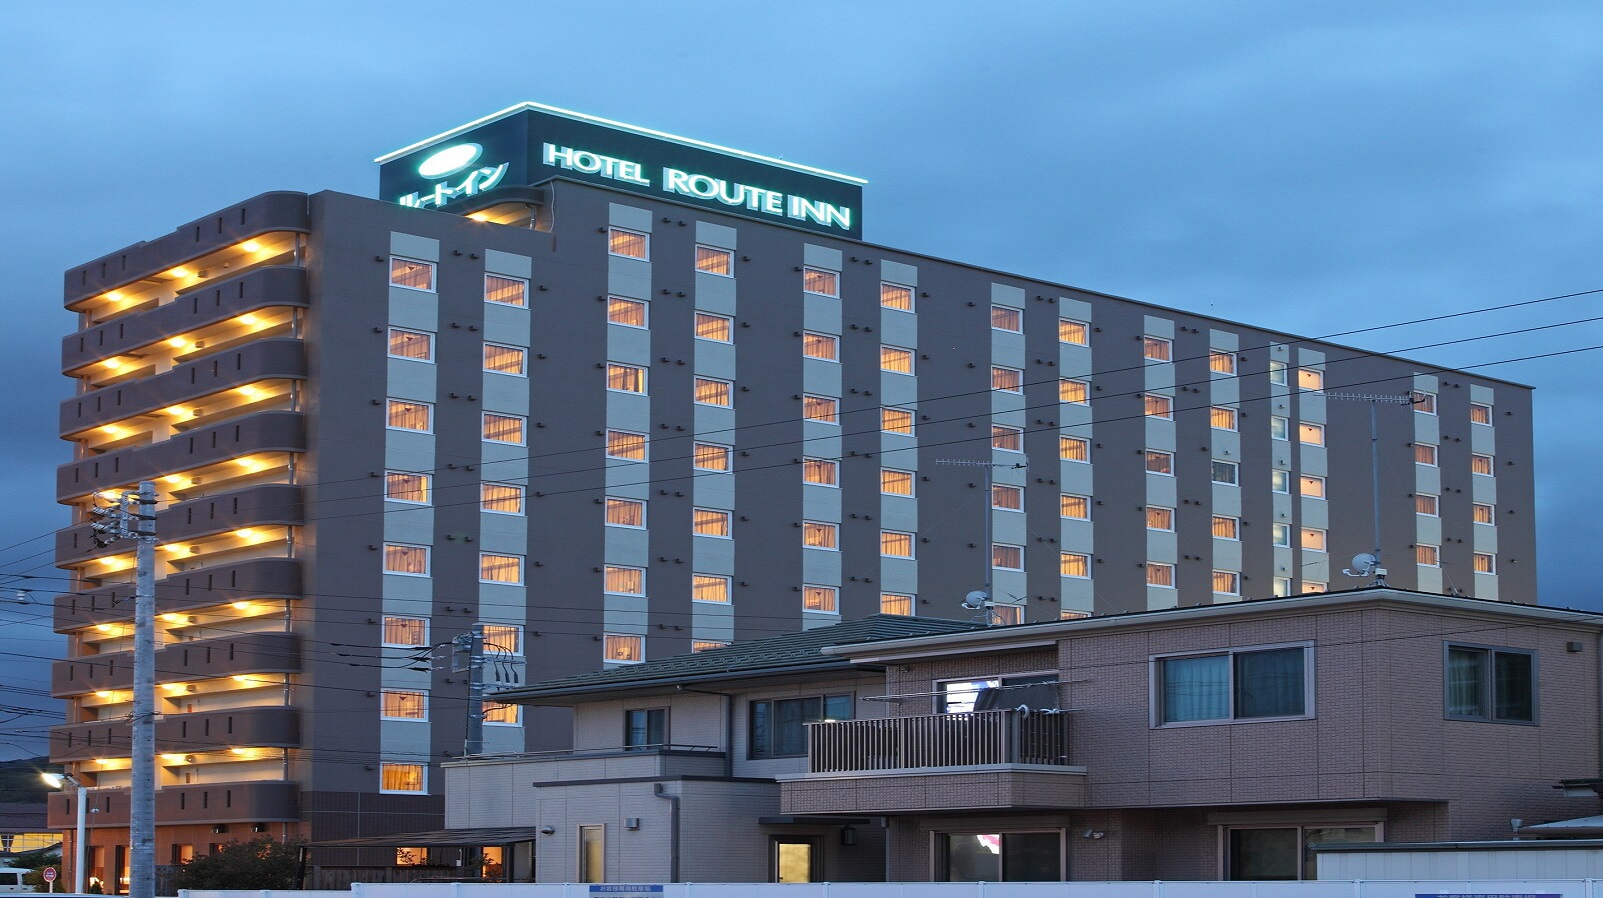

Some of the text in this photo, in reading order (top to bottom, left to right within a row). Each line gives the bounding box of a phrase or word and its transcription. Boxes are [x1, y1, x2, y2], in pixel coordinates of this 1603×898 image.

[543, 142, 850, 231] HOTEL ROUTE INN
